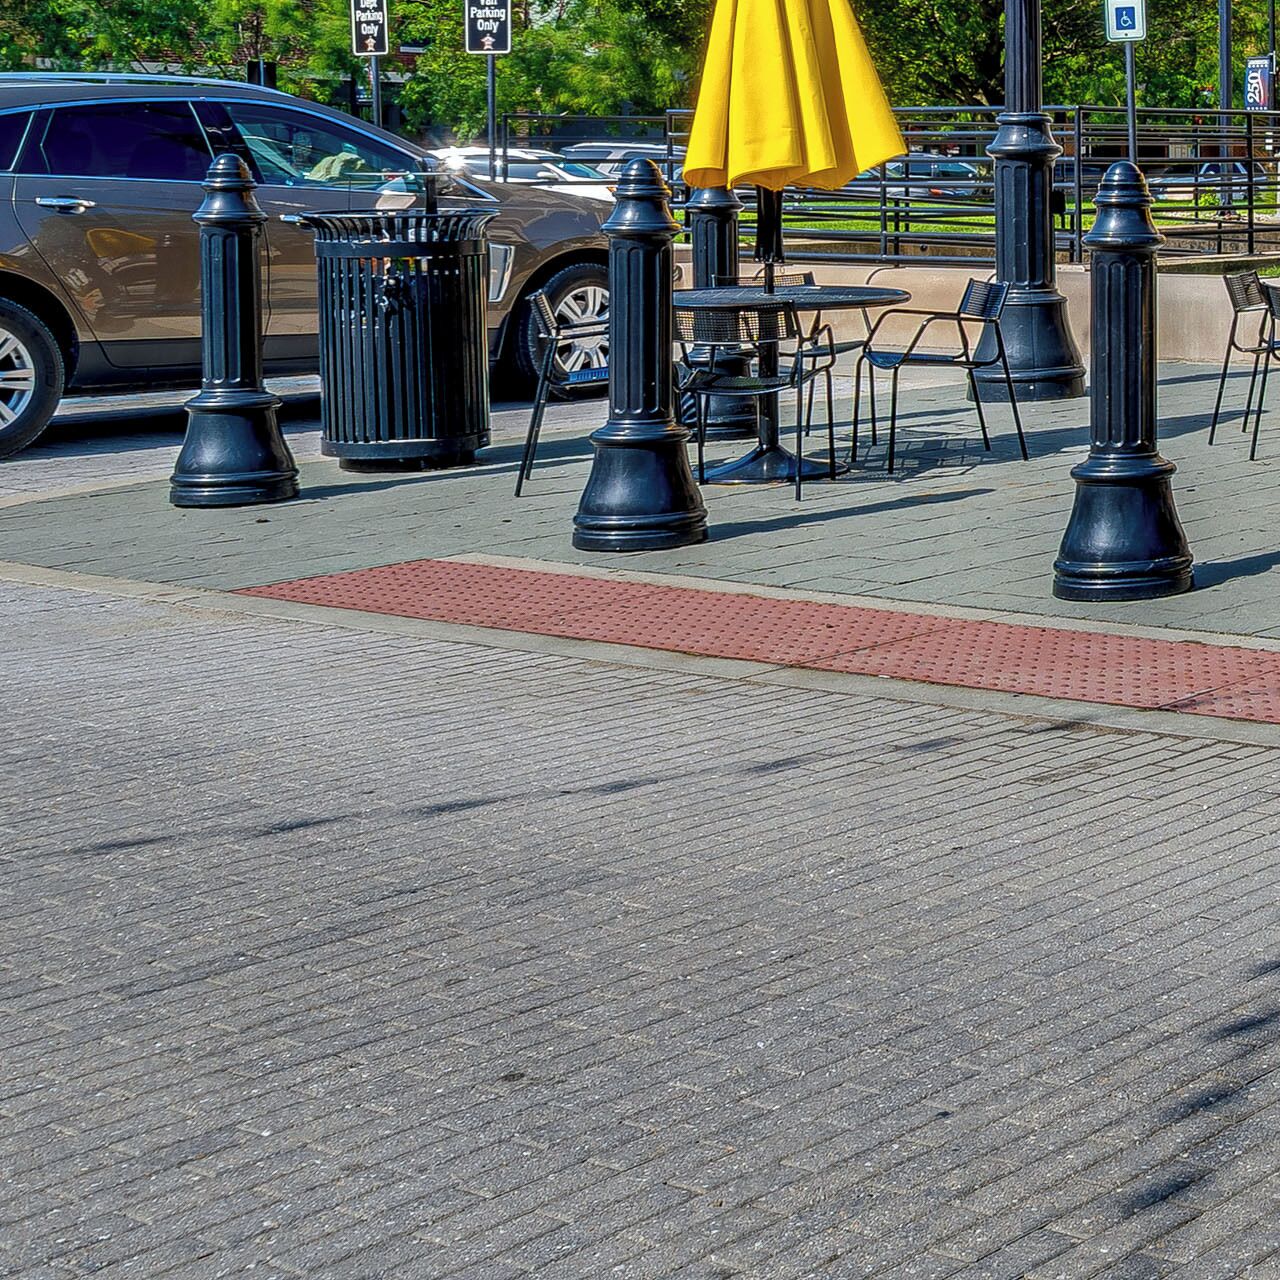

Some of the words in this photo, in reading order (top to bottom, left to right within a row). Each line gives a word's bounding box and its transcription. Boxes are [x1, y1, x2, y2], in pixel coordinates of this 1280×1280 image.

[356, 10, 383, 24] Parking
[470, 6, 505, 21] Parking
[361, 23, 379, 37] Only
[477, 19, 499, 33] Only
[1247, 72, 1260, 103] 250
